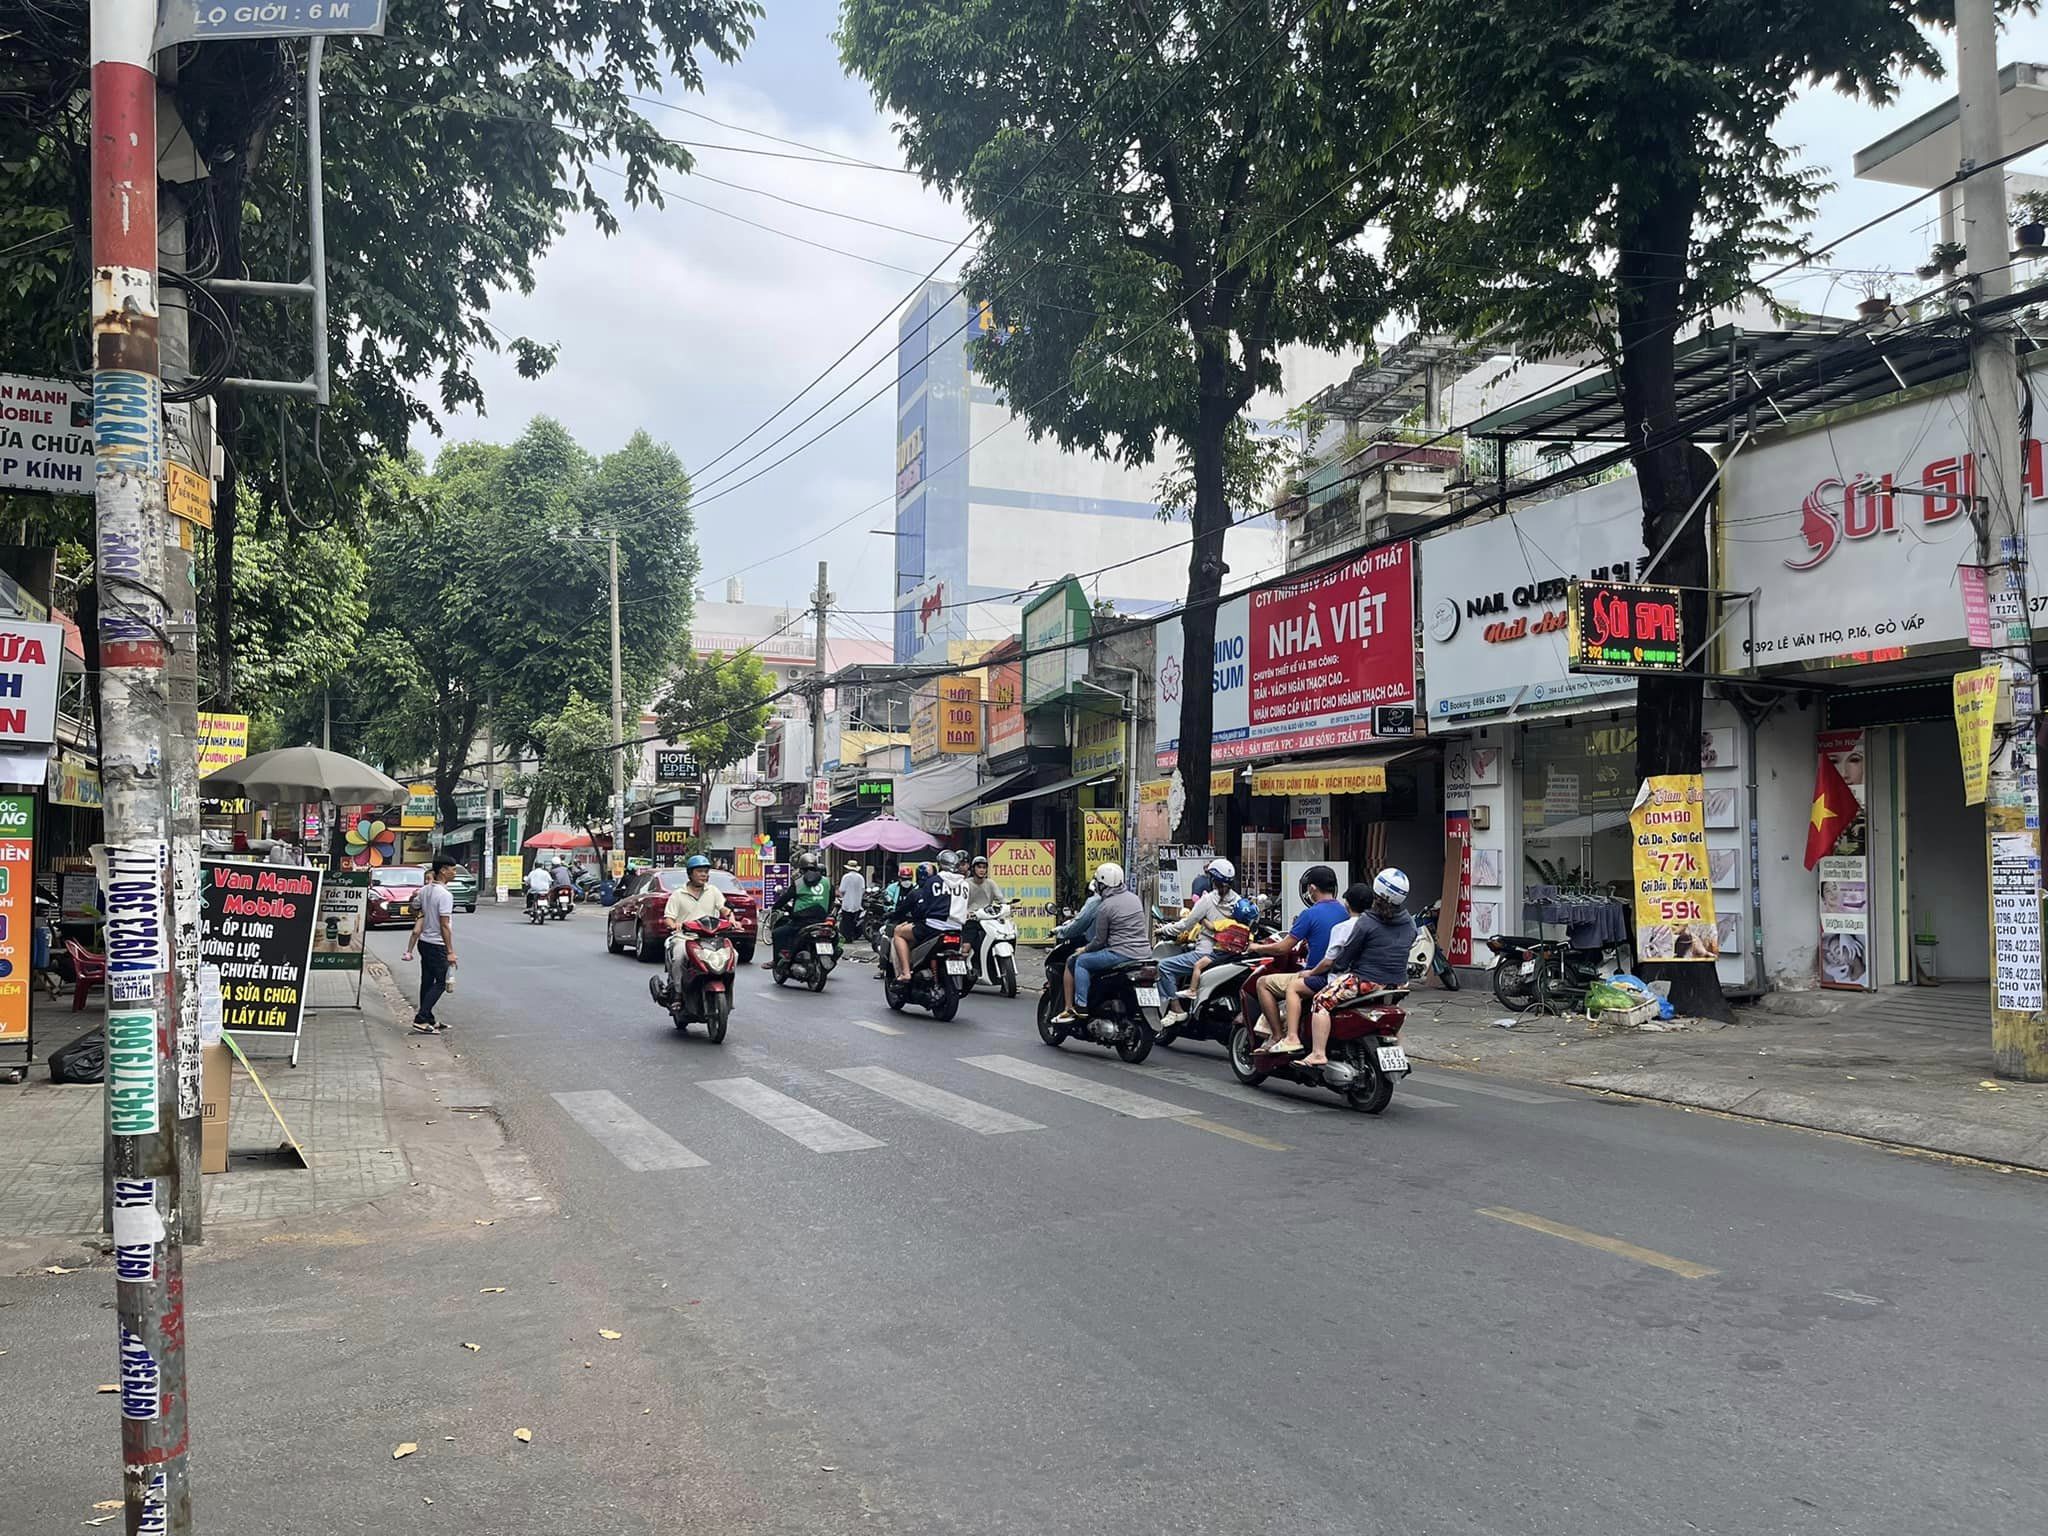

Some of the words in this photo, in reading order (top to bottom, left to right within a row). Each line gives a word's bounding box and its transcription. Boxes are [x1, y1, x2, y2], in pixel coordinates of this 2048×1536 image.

[234, 2, 287, 23] GIỚI
[309, 5, 322, 19] 6
[329, 3, 351, 19] M
[17, 387, 68, 405] MẠNH
[0, 403, 53, 424] OBILE
[32, 433, 95, 457] CHỮA
[0, 458, 18, 475] P
[26, 457, 82, 482] KÍNH
[1256, 590, 1272, 608] CTY
[1351, 554, 1372, 579] NỘI
[1374, 543, 1403, 569] THẤT
[1268, 602, 1322, 660] NHÀ
[1330, 586, 1387, 649] VIỆT
[1635, 602, 1677, 641] SPA
[1754, 640, 1773, 653] 392
[1777, 634, 1789, 651] LÊ
[1792, 632, 1816, 647] VĂN
[1874, 621, 1897, 636] GÒ
[1901, 612, 1926, 633] VẤP
[1306, 675, 1328, 692] THẠCH
[1328, 671, 1343, 686] CAO
[1270, 704, 1286, 718] CUNG
[1321, 695, 1337, 709] CHO
[1362, 686, 1386, 705] THẠCH
[947, 730, 975, 745] NAM
[660, 752, 698, 764] HOTEL
[663, 763, 695, 772] EDEN
[1645, 810, 1692, 825] COMBO
[1031, 864, 1052, 876] CAO
[1658, 852, 1697, 872] 77k
[214, 867, 253, 890] Van
[256, 871, 313, 896] Mạnh
[108, 847, 157, 961] 0923.390.777
[222, 894, 297, 919] Mobile
[1661, 901, 1701, 920] 59k
[1995, 897, 2015, 908] CHO
[2019, 897, 2038, 908] VAY
[222, 916, 240, 936] ỐP
[241, 922, 274, 939] LƯNG
[1997, 925, 2017, 936] CHO
[2021, 925, 2039, 936] VAY
[1450, 937, 1468, 955] CAO
[1998, 952, 2018, 963] CHO
[2023, 953, 2040, 964] VAY
[234, 981, 261, 1003] SỬA
[263, 985, 297, 1005] CHỮA
[1999, 981, 2019, 991] CHO
[2024, 981, 2041, 991] VAY
[231, 1004, 256, 1025] LẤY
[110, 1015, 155, 1132] 0345.779.668
